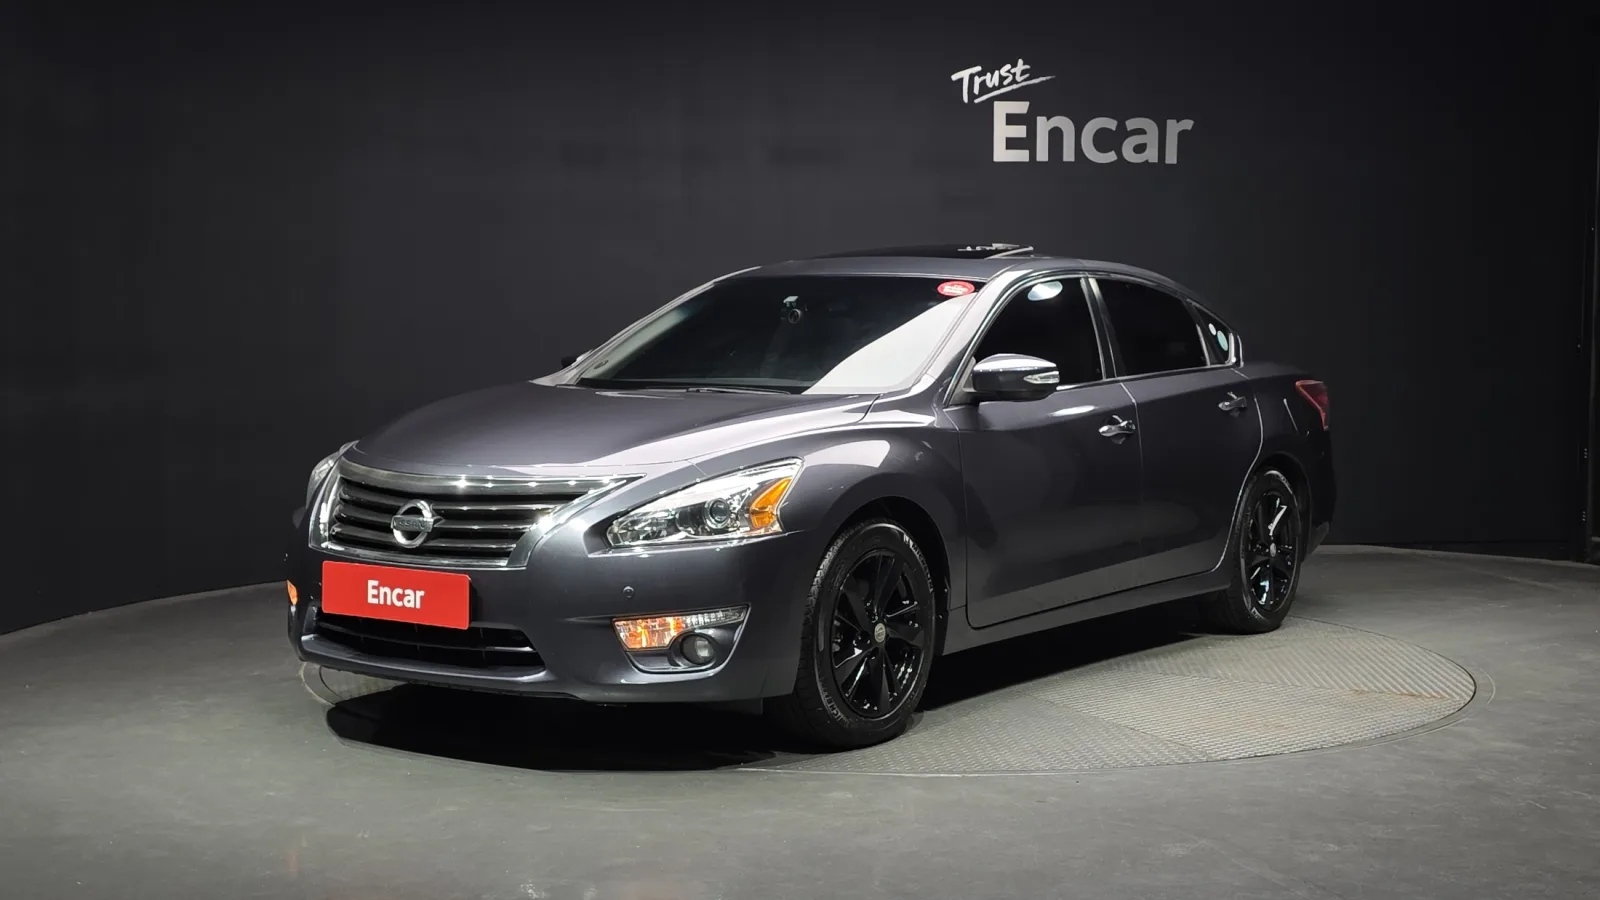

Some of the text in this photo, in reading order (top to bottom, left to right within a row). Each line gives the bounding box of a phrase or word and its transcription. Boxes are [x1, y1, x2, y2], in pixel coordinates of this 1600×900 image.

[951, 59, 1033, 103] Trust
[993, 101, 1195, 164] Encar
[393, 518, 426, 531] NSSAN
[367, 580, 425, 609] Encar
